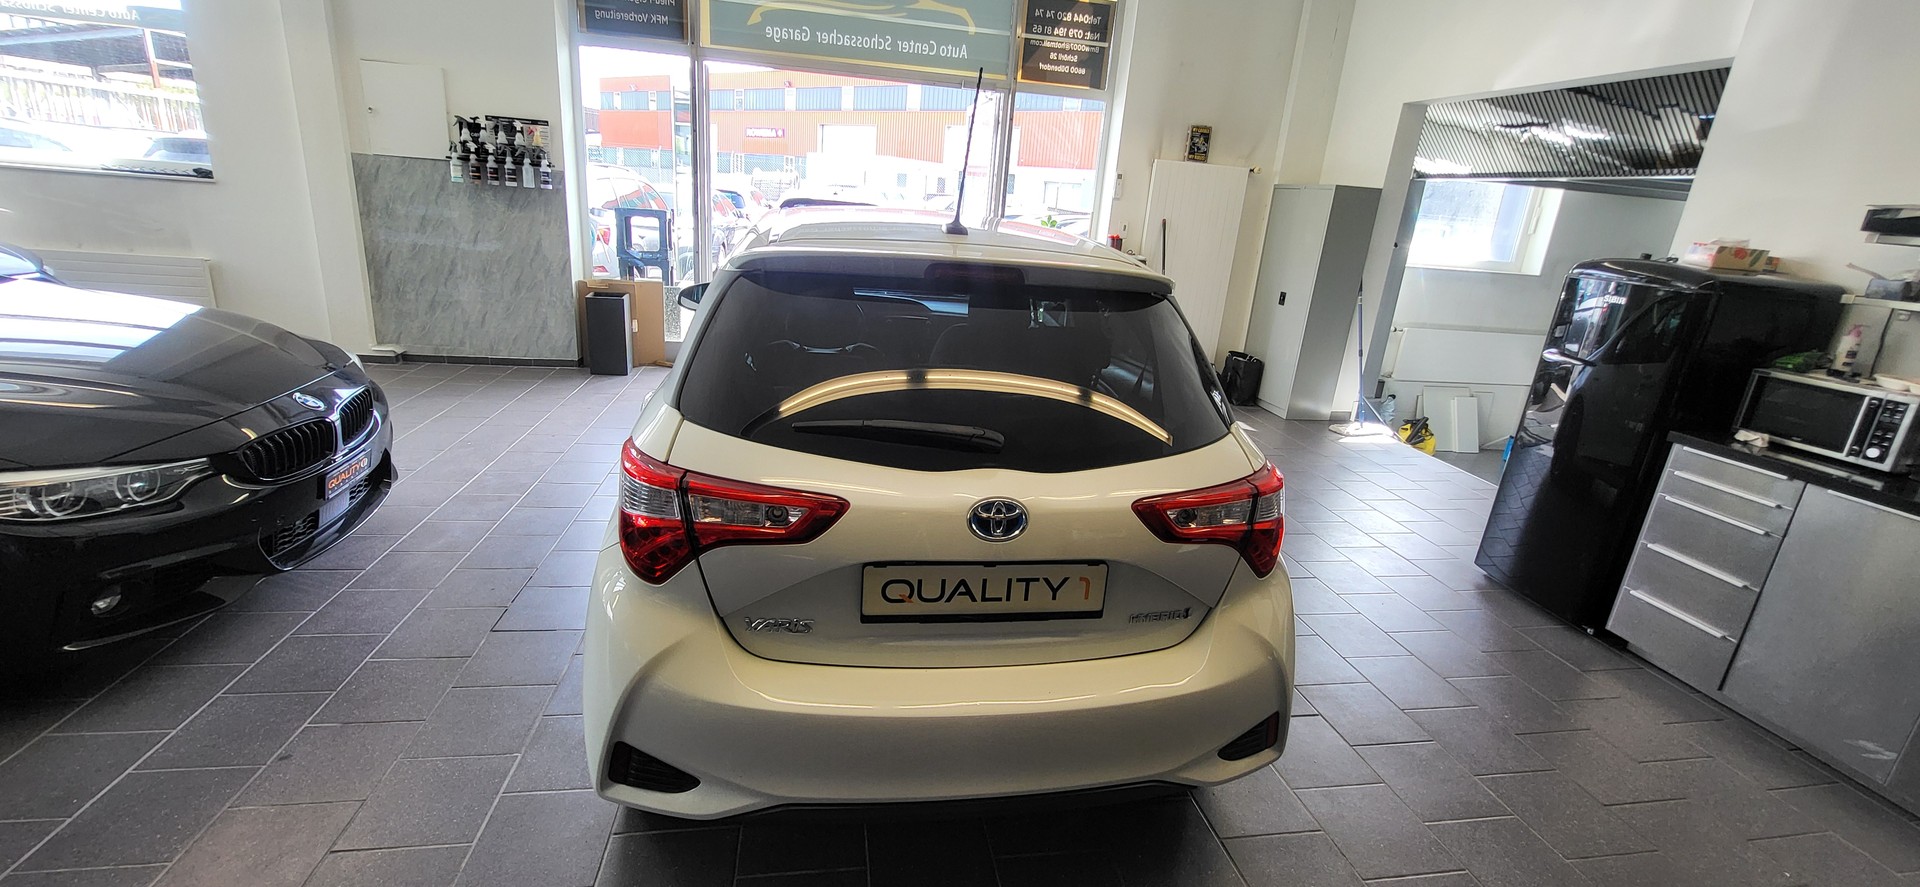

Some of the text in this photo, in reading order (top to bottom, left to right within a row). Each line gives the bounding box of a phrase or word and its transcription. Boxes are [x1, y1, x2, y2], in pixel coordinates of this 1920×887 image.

[328, 462, 360, 489] QUALITY
[881, 576, 1091, 604] QUALITY 1
